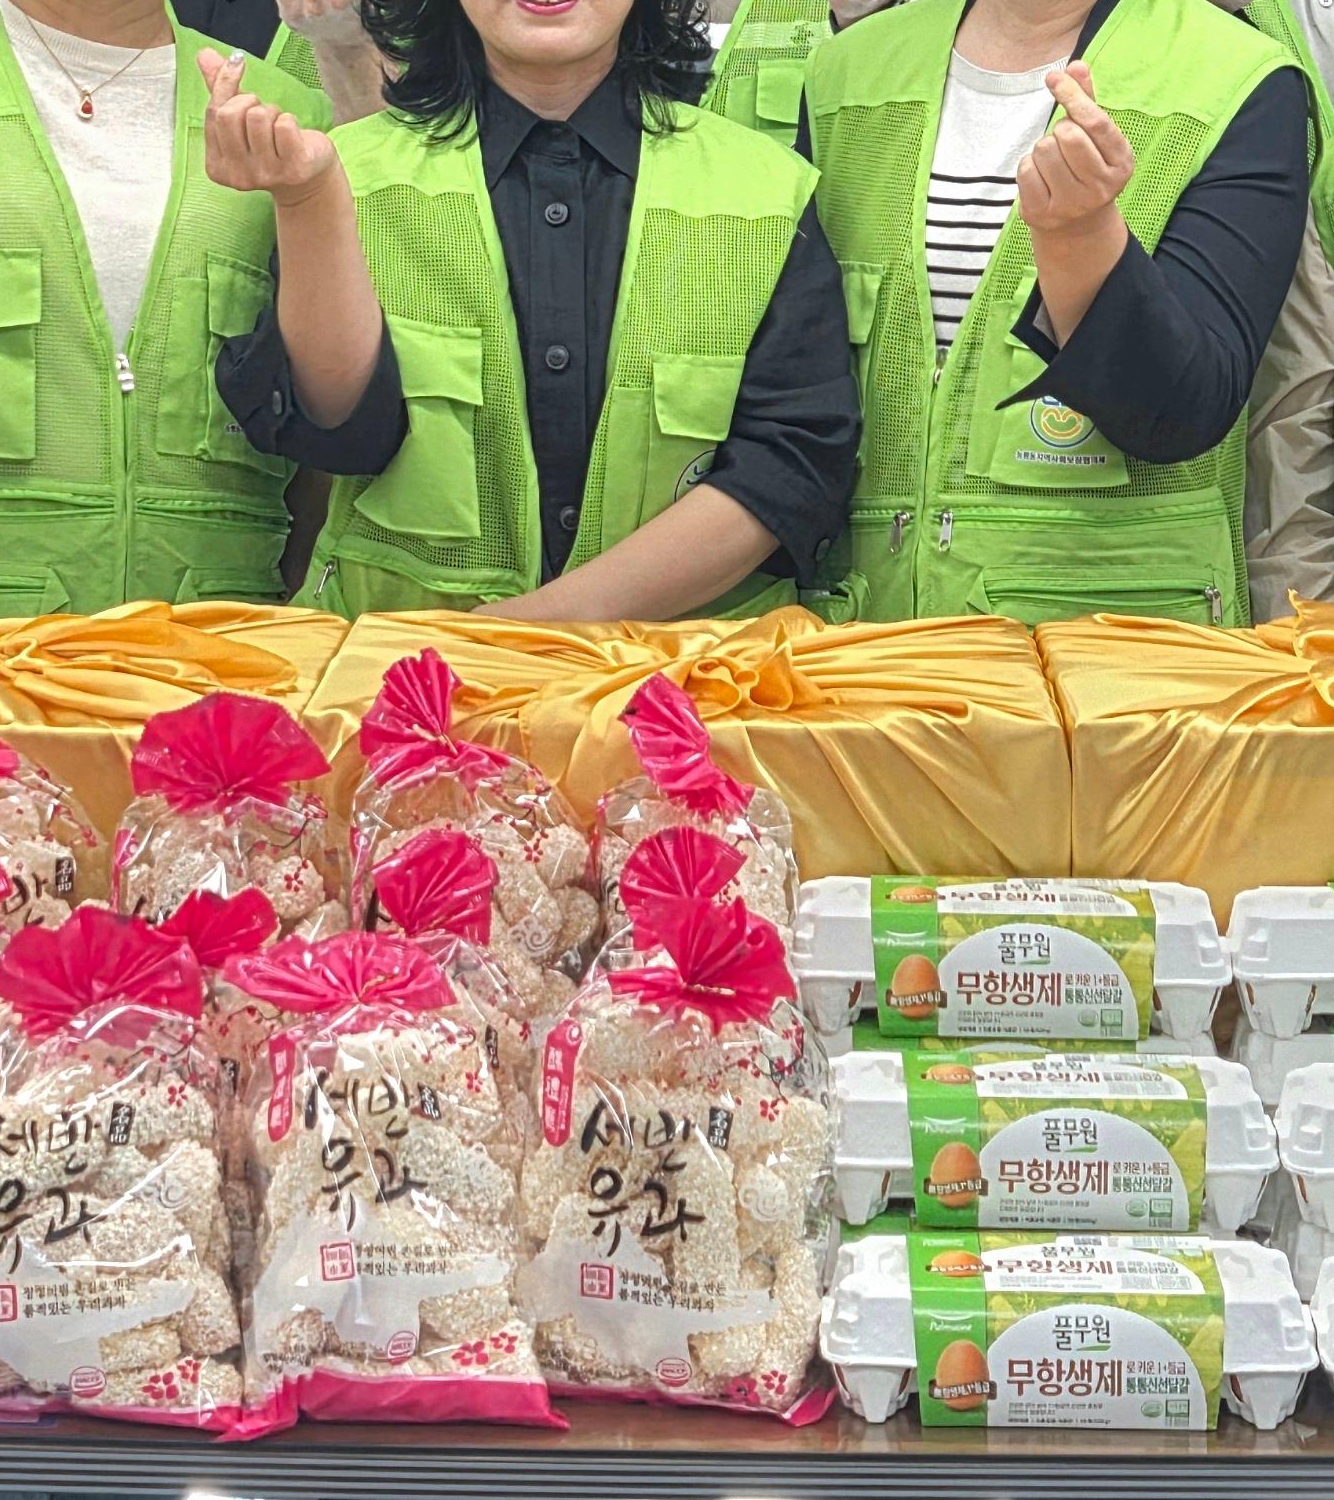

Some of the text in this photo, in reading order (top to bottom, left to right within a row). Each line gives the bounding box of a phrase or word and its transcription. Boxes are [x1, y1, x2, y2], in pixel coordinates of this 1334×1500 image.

[997, 932, 1051, 965] 풀무원
[957, 970, 1062, 1006] 무항생제
[1042, 1118, 1098, 1153] 풀무원
[998, 1158, 1109, 1196] 무항생제
[588, 1167, 705, 1257] 유과
[1052, 1314, 1112, 1351] 풀무원
[1006, 1358, 1123, 1398] 무항생제
